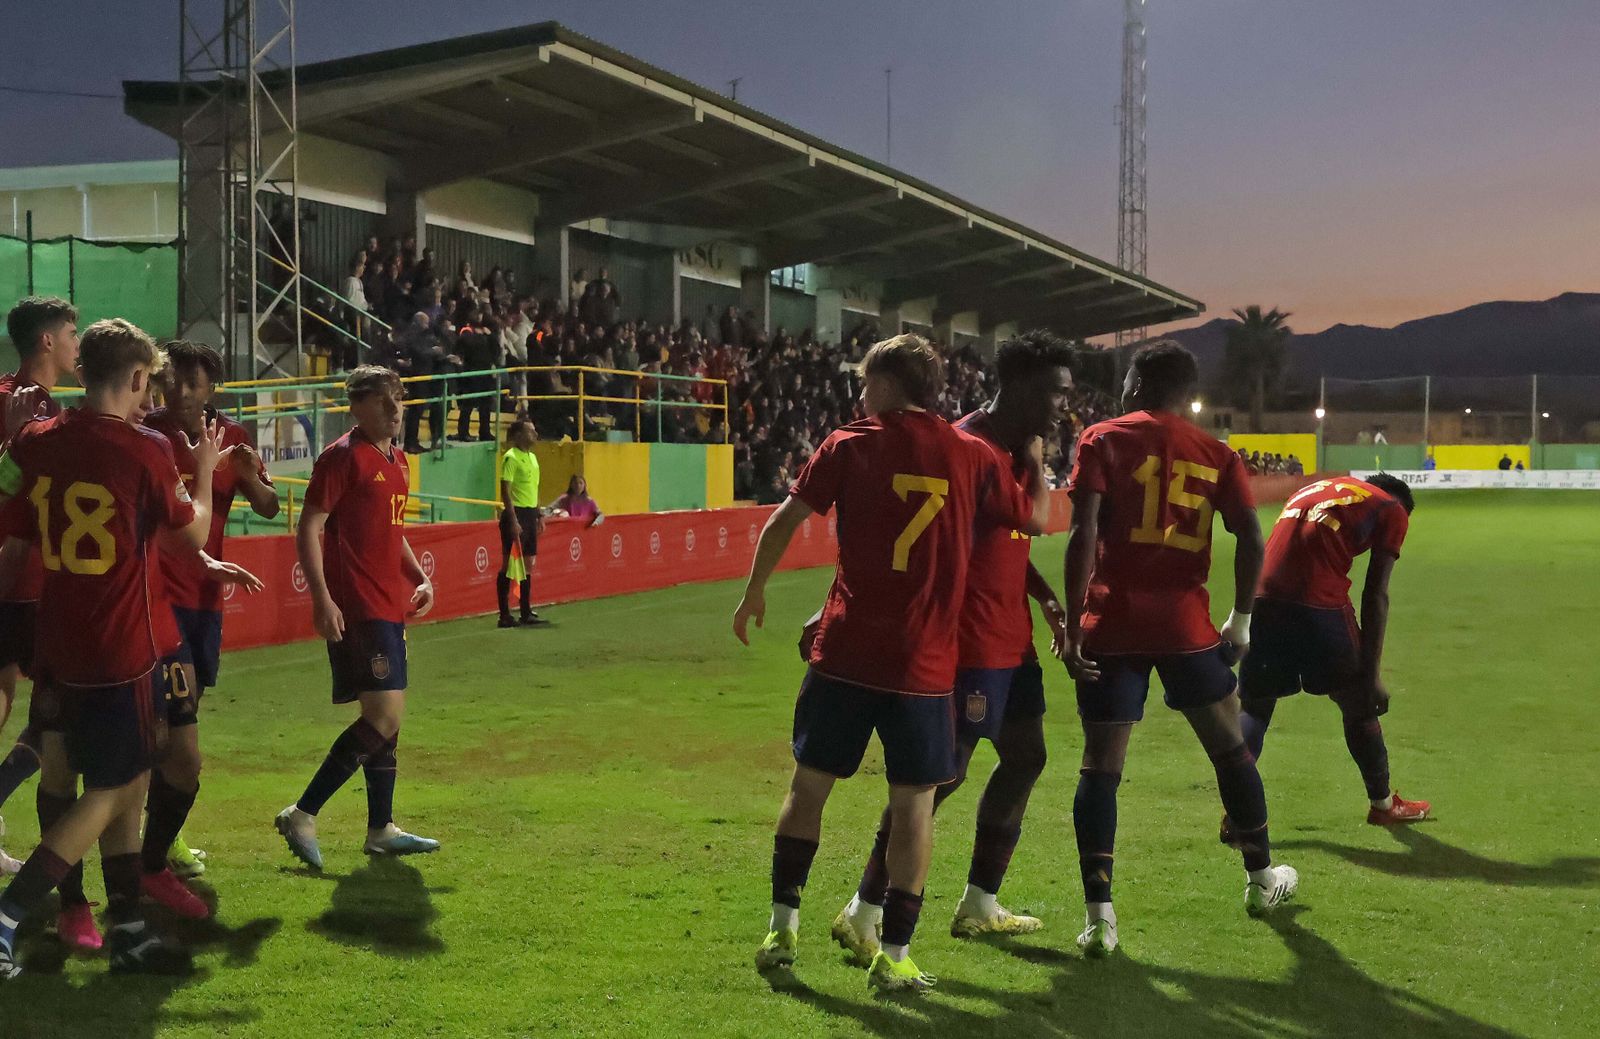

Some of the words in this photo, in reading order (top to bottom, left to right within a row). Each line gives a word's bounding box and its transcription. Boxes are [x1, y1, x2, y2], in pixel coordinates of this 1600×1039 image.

[30, 476, 117, 575] 18
[892, 474, 949, 571] 7
[1130, 455, 1219, 553] 15
